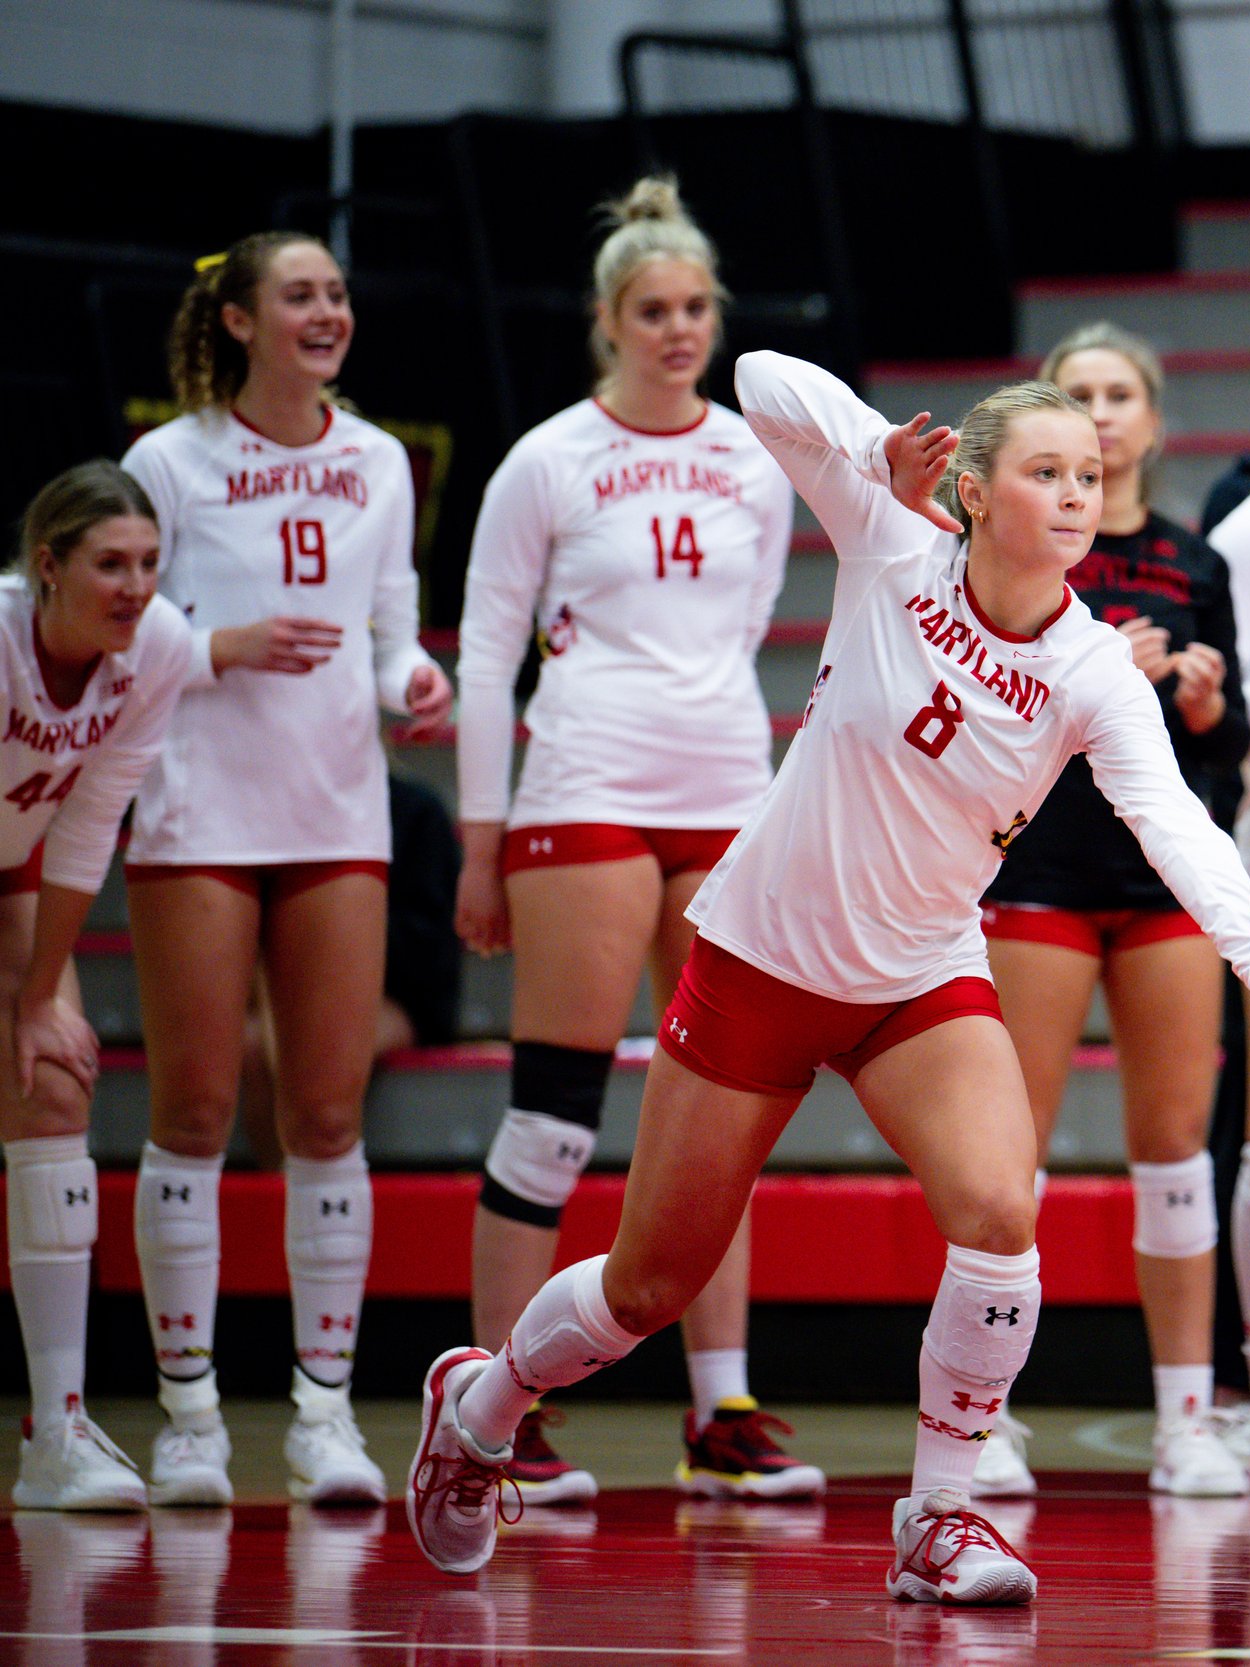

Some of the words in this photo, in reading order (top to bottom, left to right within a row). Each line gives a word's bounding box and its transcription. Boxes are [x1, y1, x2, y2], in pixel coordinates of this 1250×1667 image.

[226, 461, 368, 510] MARYLAND
[280, 518, 327, 586] 19
[651, 516, 704, 580] 14
[904, 594, 1050, 722] MARYLAND
[3, 707, 122, 753] MARYLAN
[903, 679, 964, 759] 8
[5, 763, 83, 812] 44
